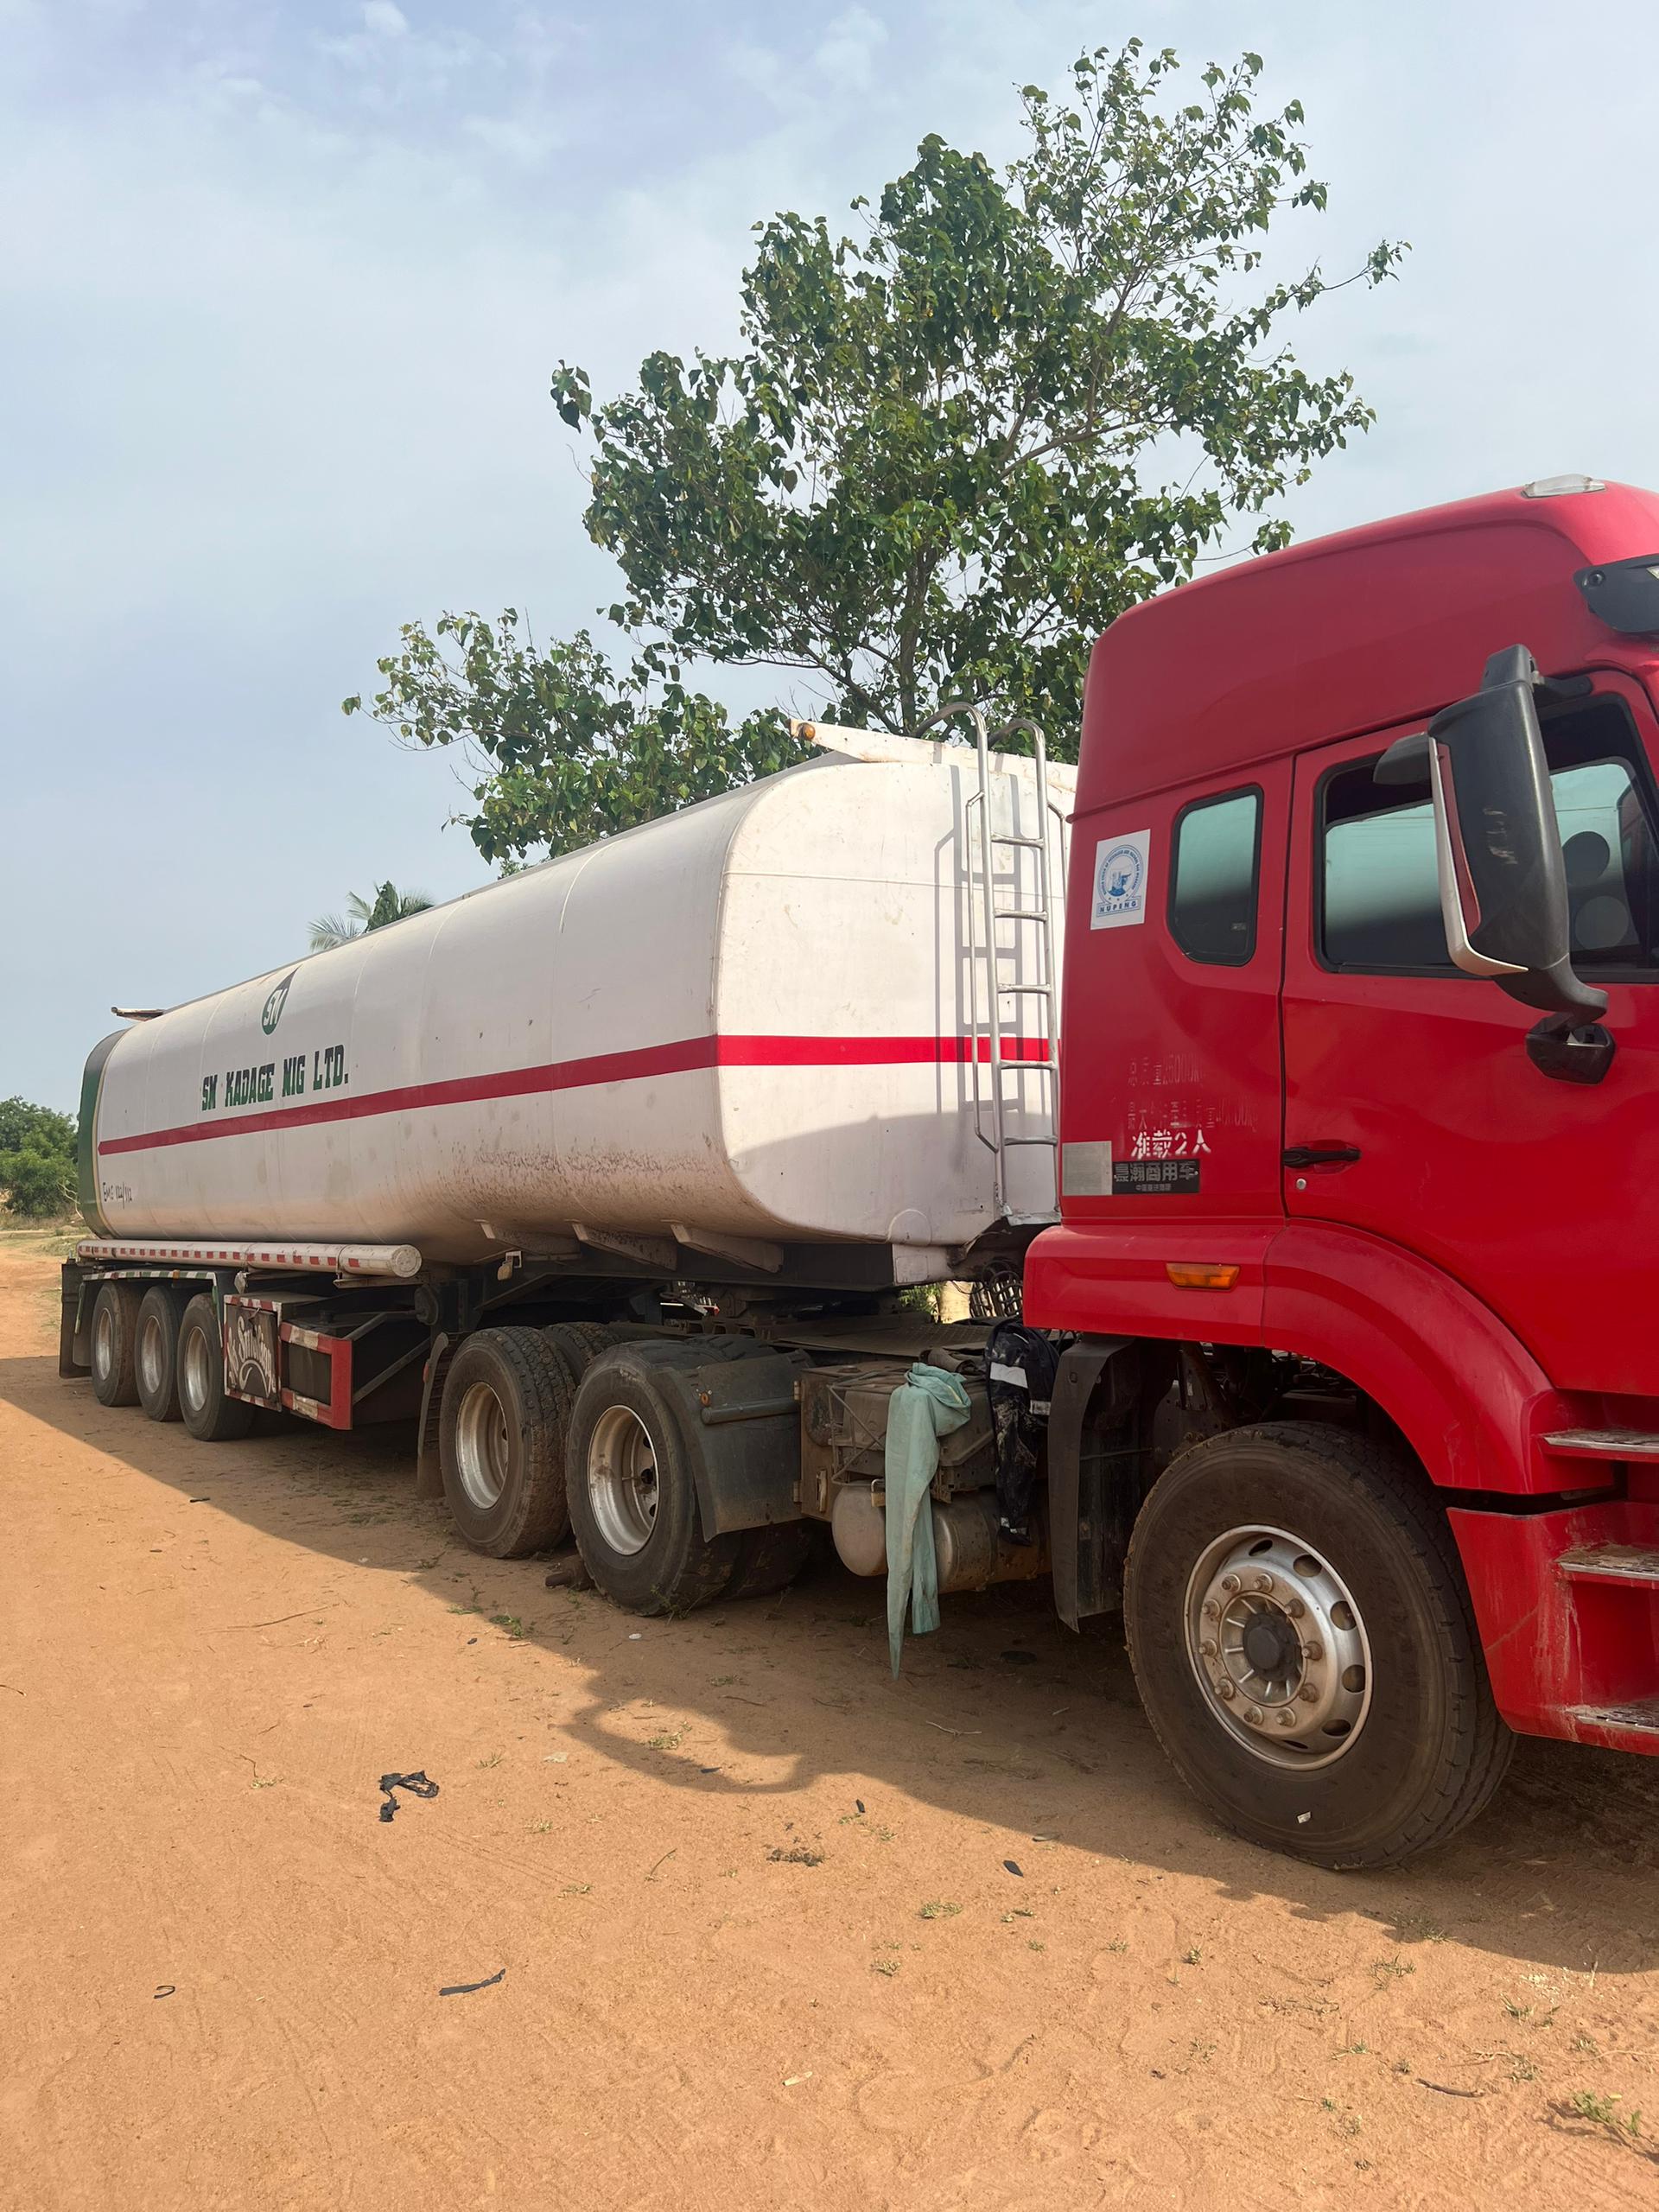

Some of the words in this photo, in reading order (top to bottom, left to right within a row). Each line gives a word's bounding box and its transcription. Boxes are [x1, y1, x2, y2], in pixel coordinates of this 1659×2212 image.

[1099, 900, 1137, 913] NUPENG
[225, 1063, 275, 1107] KADAGE
[282, 1054, 306, 1097] NIG
[313, 1044, 349, 1091] LTD.
